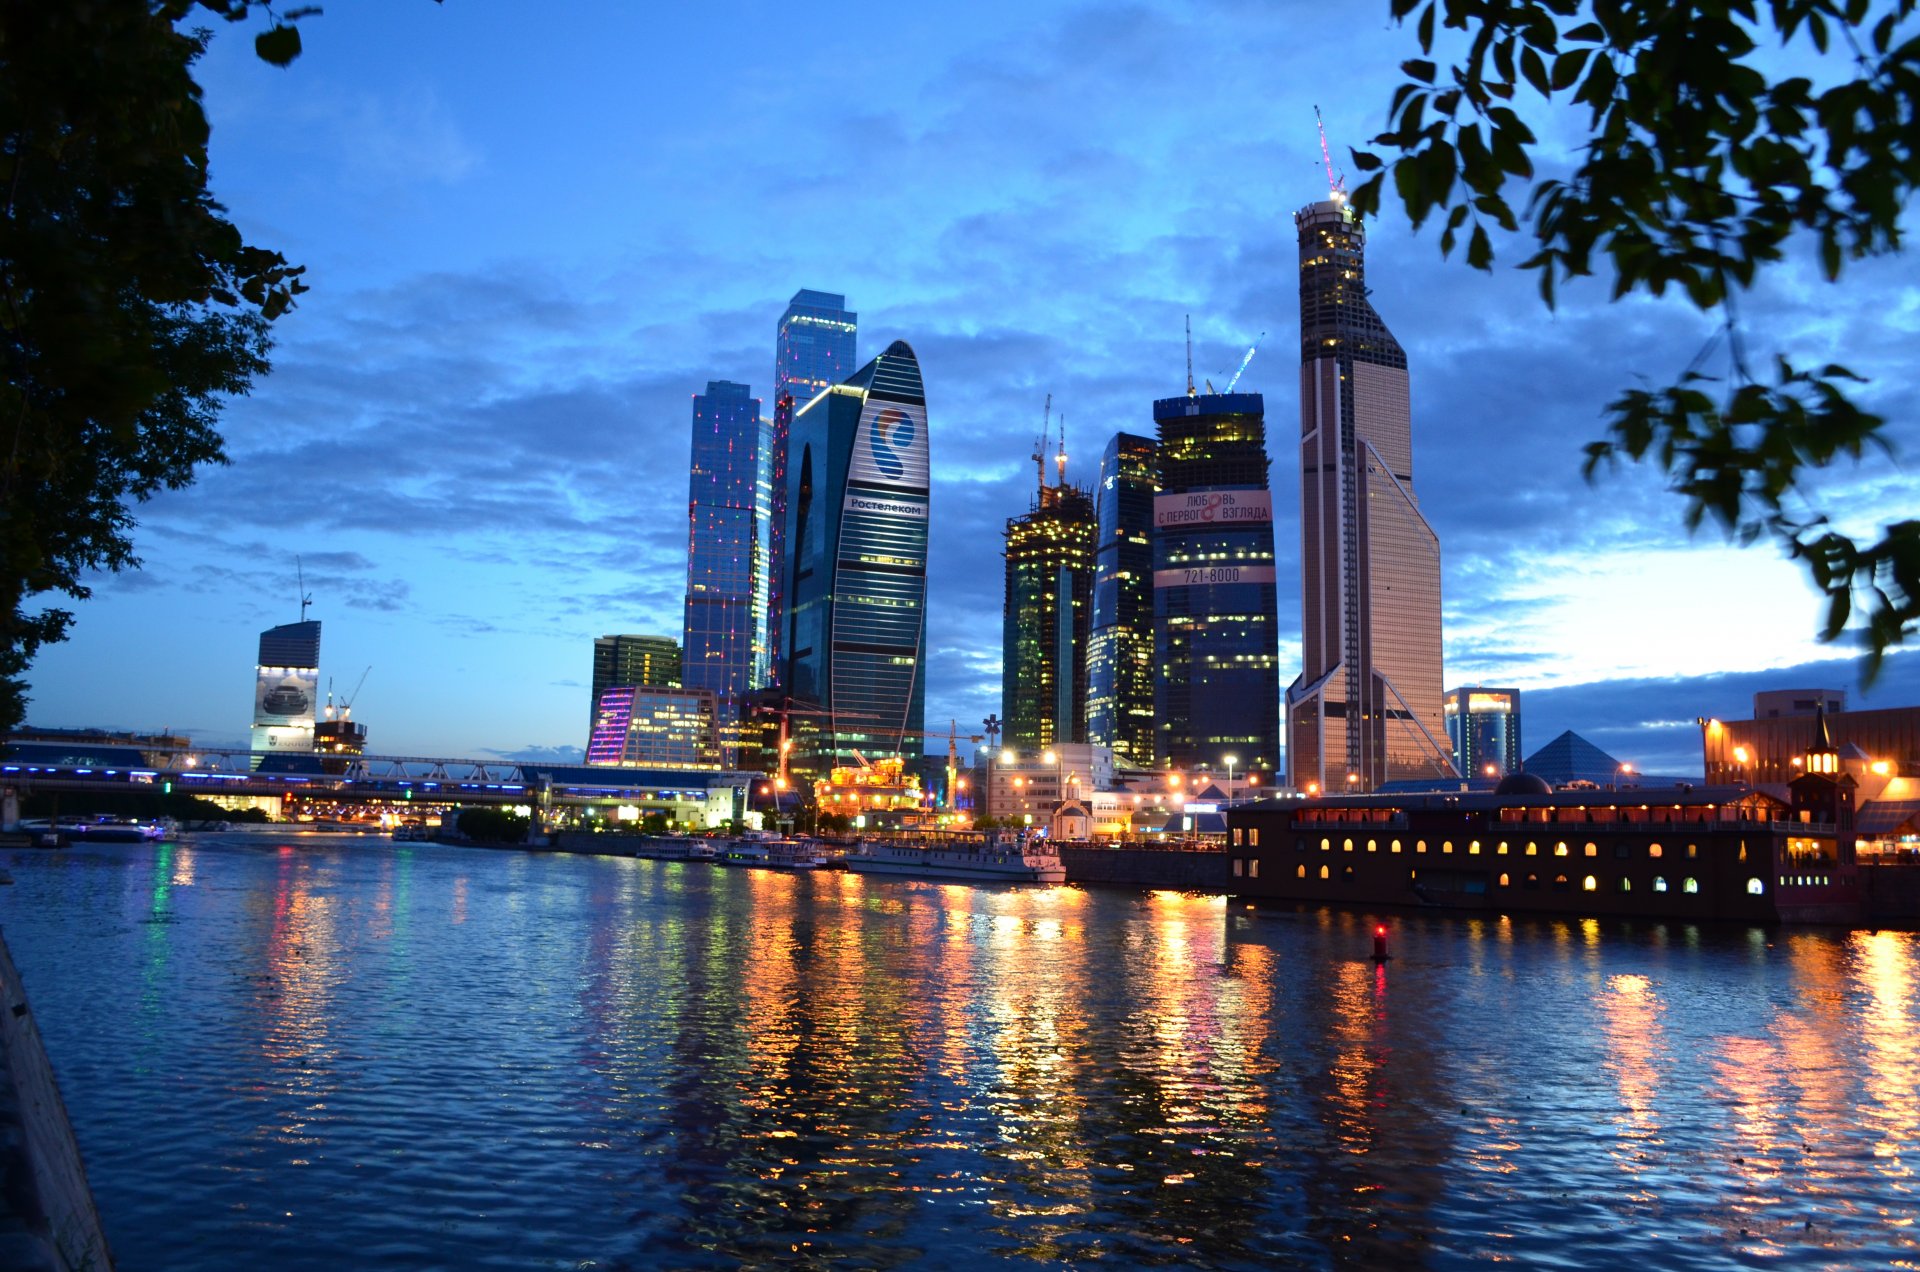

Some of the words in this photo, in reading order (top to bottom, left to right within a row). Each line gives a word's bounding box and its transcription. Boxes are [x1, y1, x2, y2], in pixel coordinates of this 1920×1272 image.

[851, 499, 921, 515] Ростелеком
[1222, 507, 1268, 520] ВЗГЛЯДА
[1184, 568, 1240, 584] 721-8000
